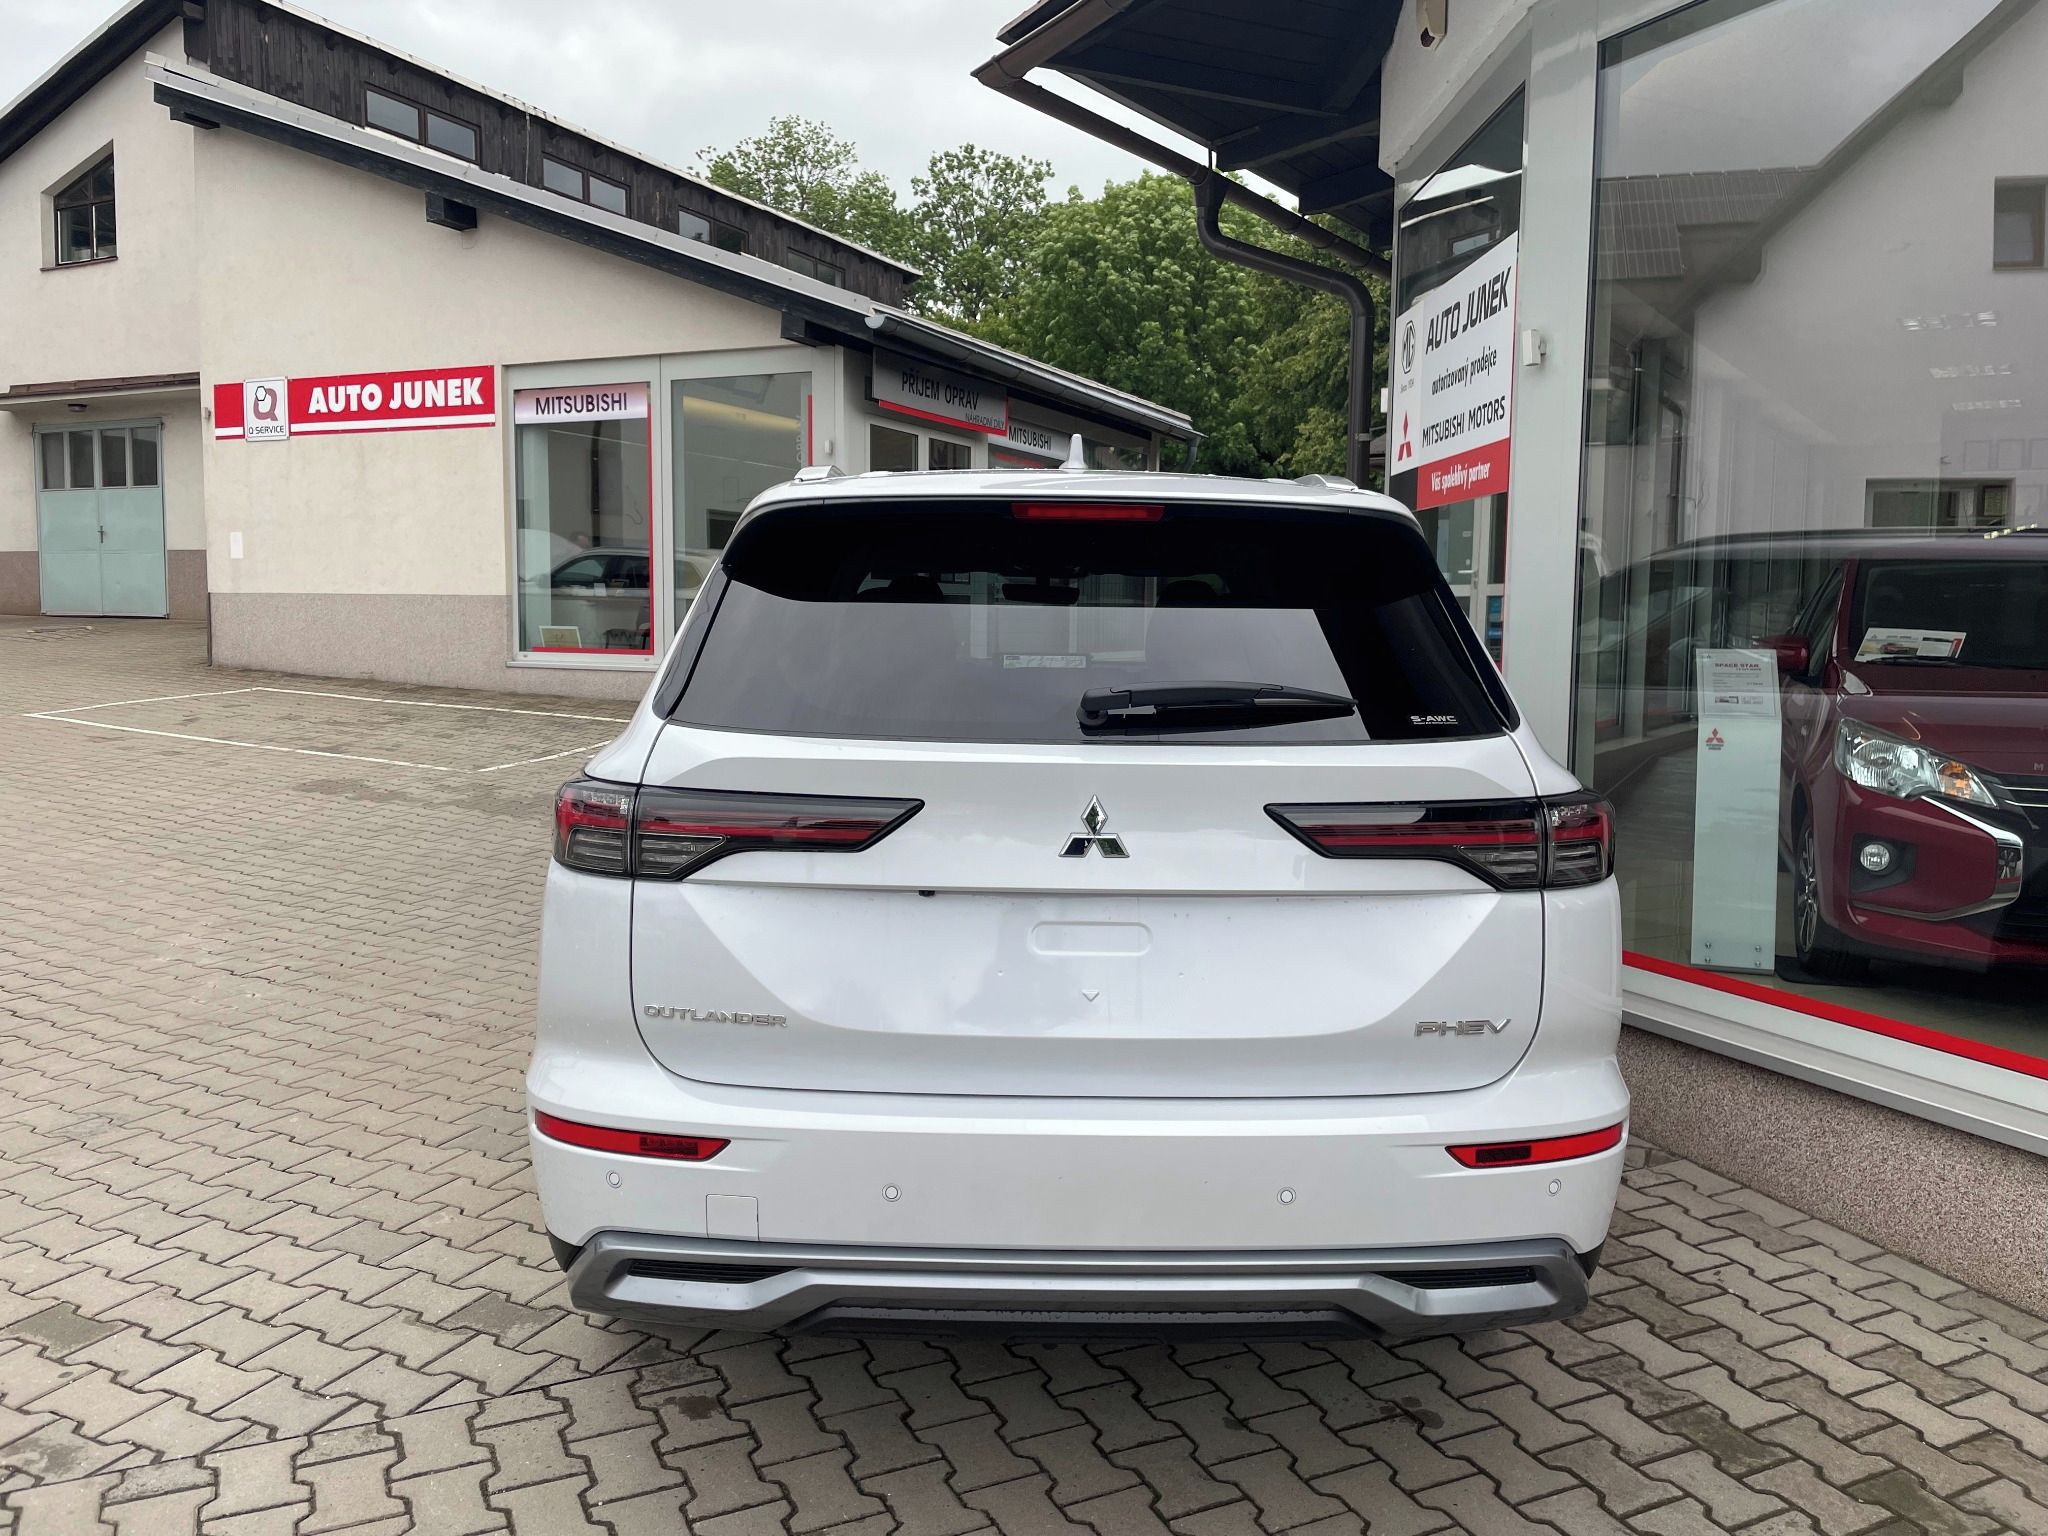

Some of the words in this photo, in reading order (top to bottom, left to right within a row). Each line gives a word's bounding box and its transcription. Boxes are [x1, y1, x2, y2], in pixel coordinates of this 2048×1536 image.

[1426, 301, 1461, 355] AUTO
[1462, 266, 1511, 334] JUNEK
[1432, 357, 1469, 395] autorizovaný
[1470, 345, 1497, 385] prodejce
[308, 383, 383, 414] AUTO
[389, 376, 484, 410] JUNEK
[535, 392, 628, 416] MITSUBISHI
[901, 367, 940, 401] PŘÍJEM
[944, 383, 980, 411] OPRAV
[255, 425, 285, 435] SERVICE
[1008, 424, 1052, 451] MITSUBISHI
[1422, 412, 1465, 449] MITSUBISHI
[1467, 395, 1506, 432] MOTORS
[1431, 471, 1442, 492] Váš
[1442, 463, 1468, 496] spolehlivý
[1468, 461, 1491, 490] partner
[643, 1004, 788, 1028] OUTLANDER
[1414, 1018, 1512, 1037] PHEV
